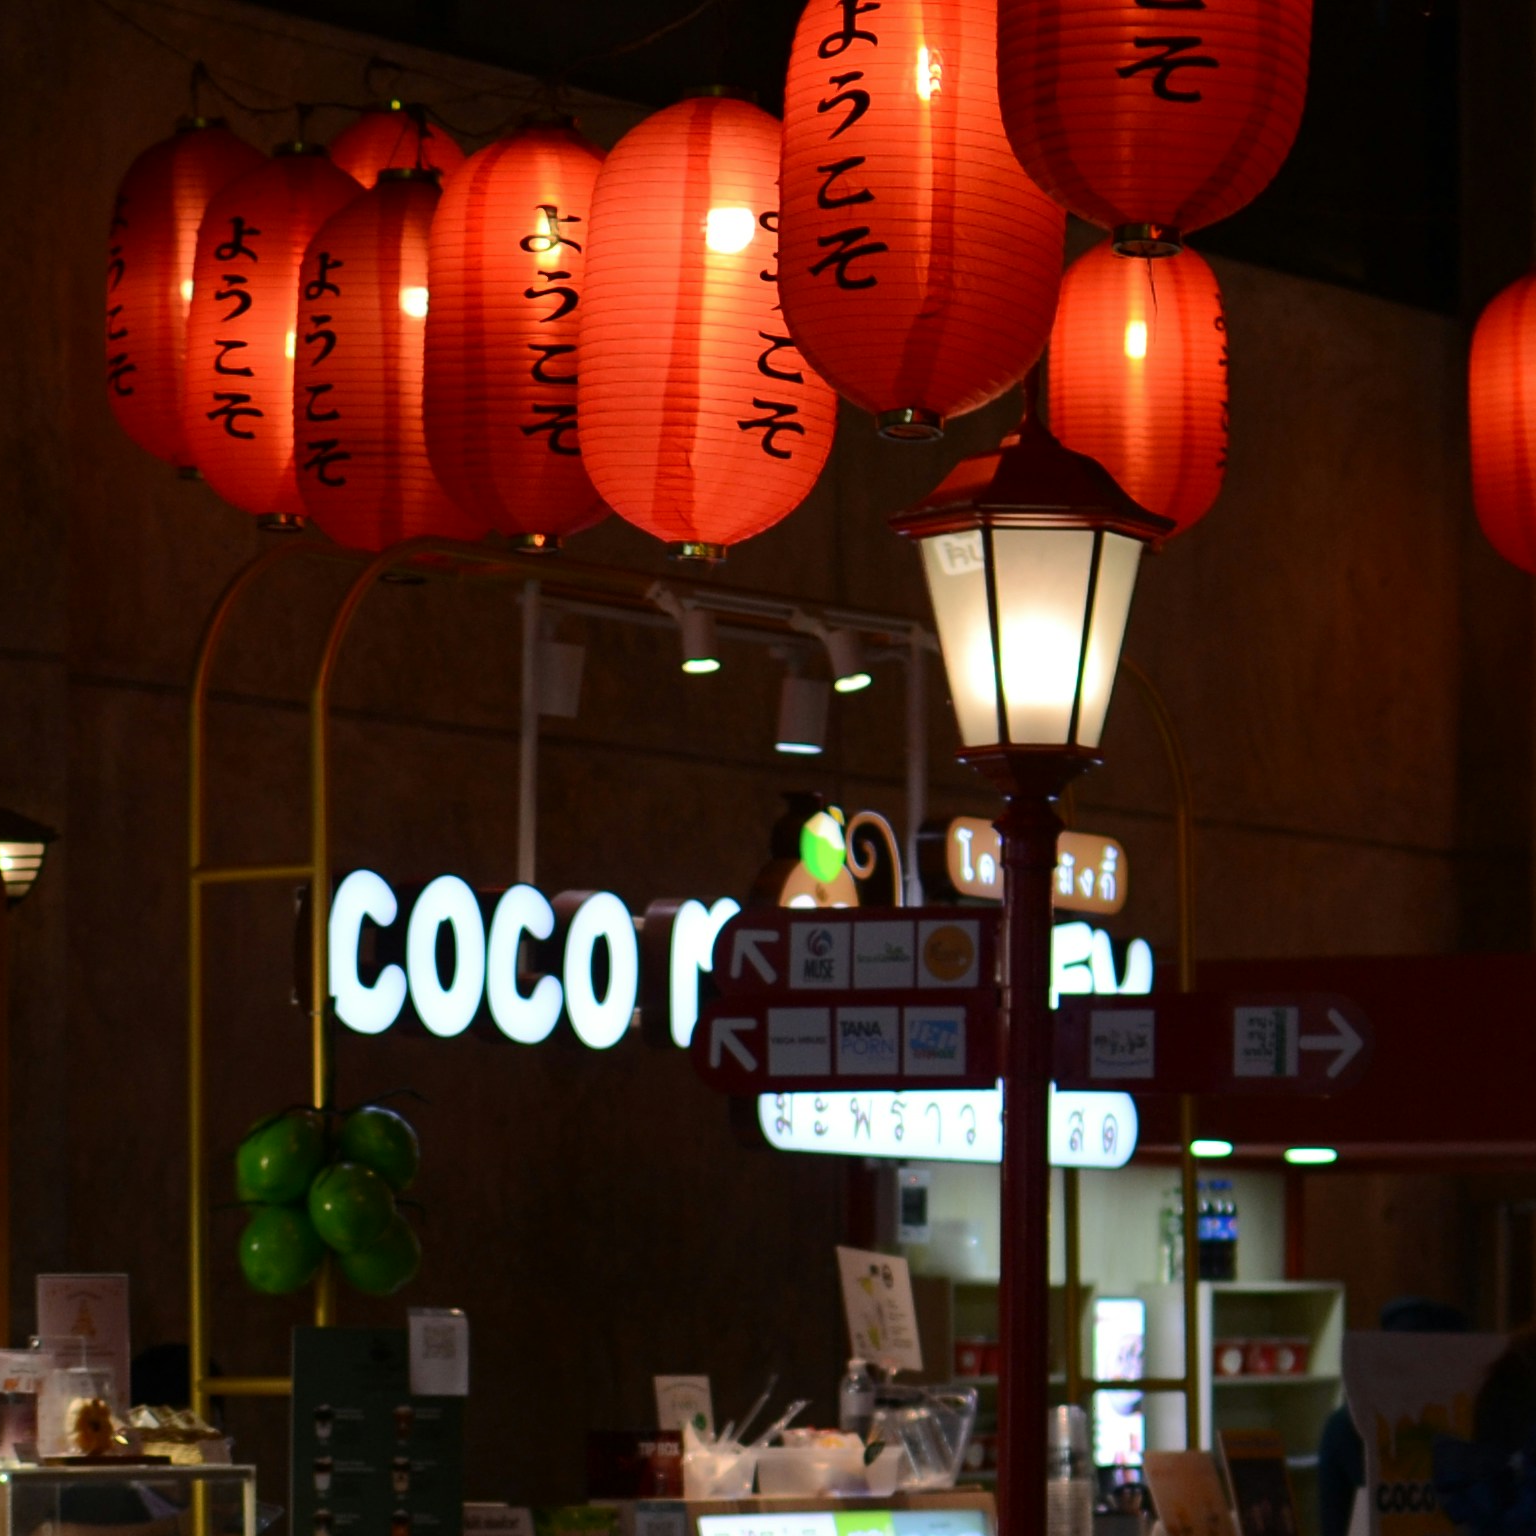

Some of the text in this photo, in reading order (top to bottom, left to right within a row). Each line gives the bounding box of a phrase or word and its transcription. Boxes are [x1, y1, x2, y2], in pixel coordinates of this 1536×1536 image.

[206, 216, 265, 441] ようこそ
[303, 251, 353, 487] ようこそ
[519, 203, 582, 456] ようこそ
[328, 867, 640, 1051] COCO
[804, 957, 835, 980] MUSE
[840, 1020, 882, 1037] TANA
[841, 1037, 895, 1055] PORN
